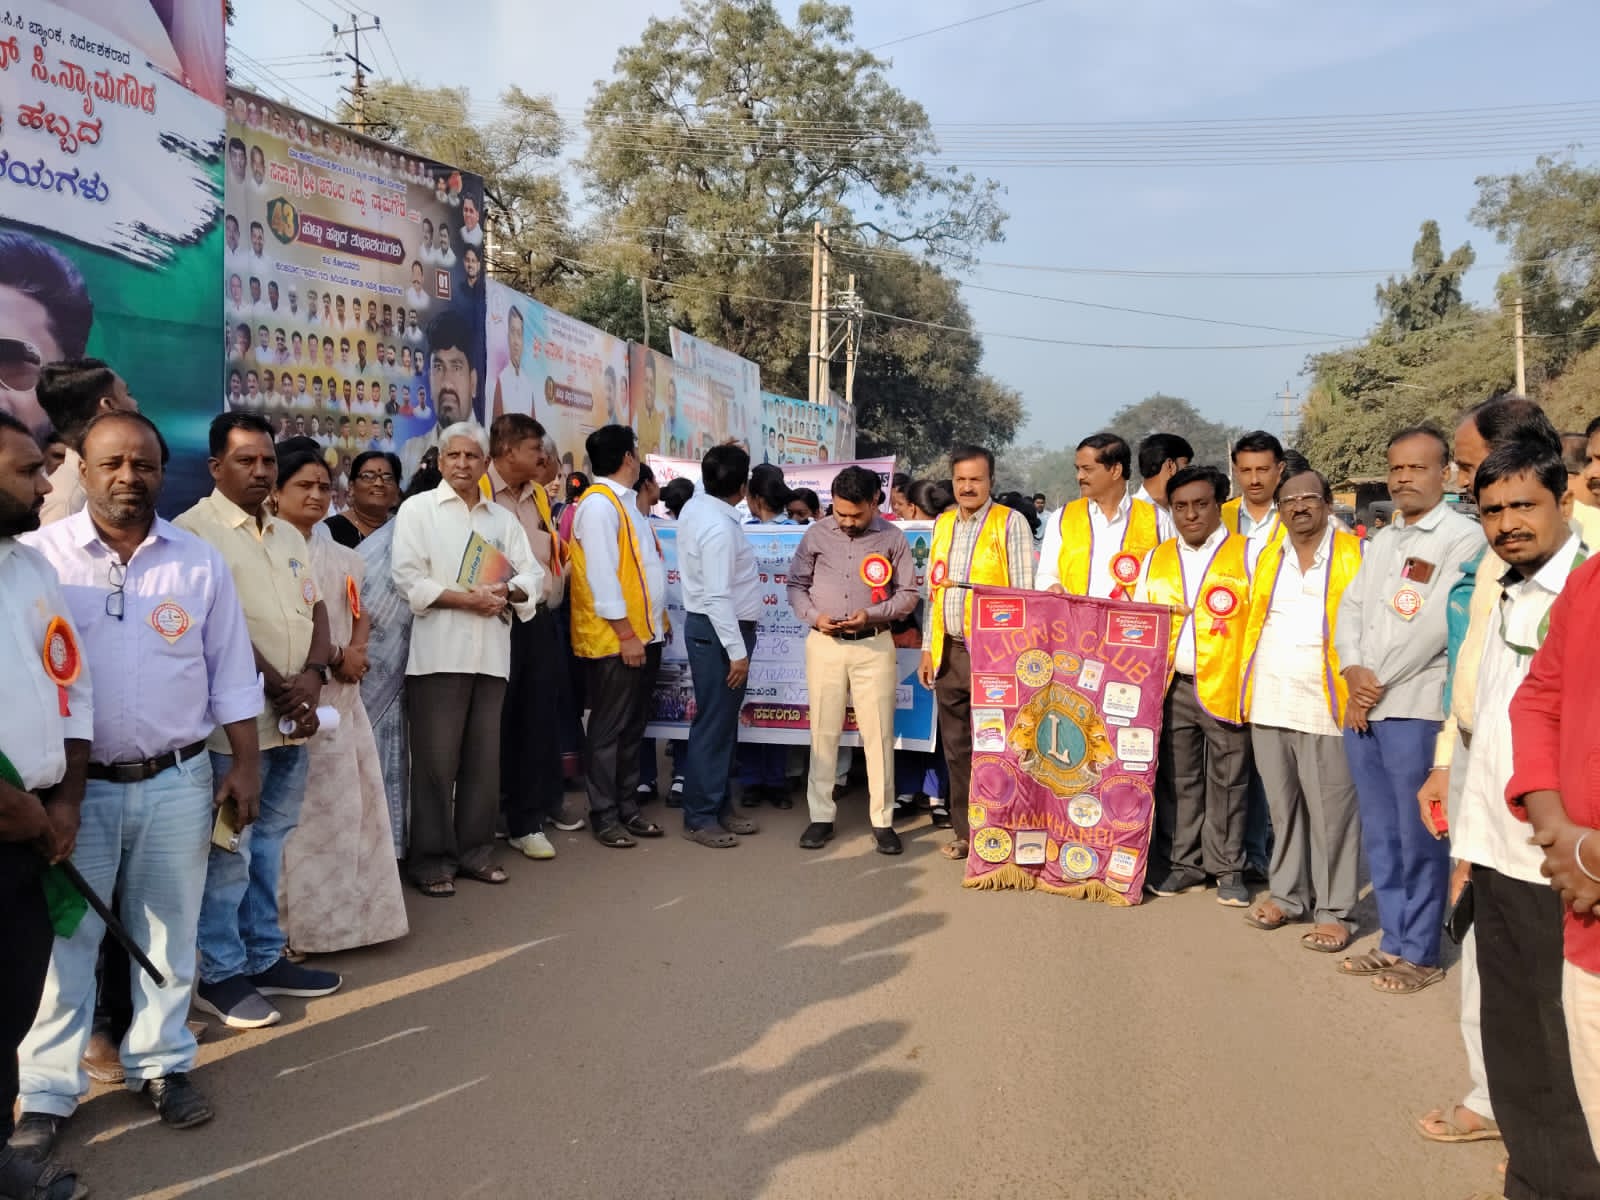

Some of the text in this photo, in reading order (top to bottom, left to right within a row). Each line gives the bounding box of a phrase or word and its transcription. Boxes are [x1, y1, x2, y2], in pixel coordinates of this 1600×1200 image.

[18, 101, 103, 154] ಹಬ್ಬದ
[272, 200, 295, 239] 43
[984, 620, 1152, 685] LIONS CLUB
[1048, 714, 1071, 766] L
